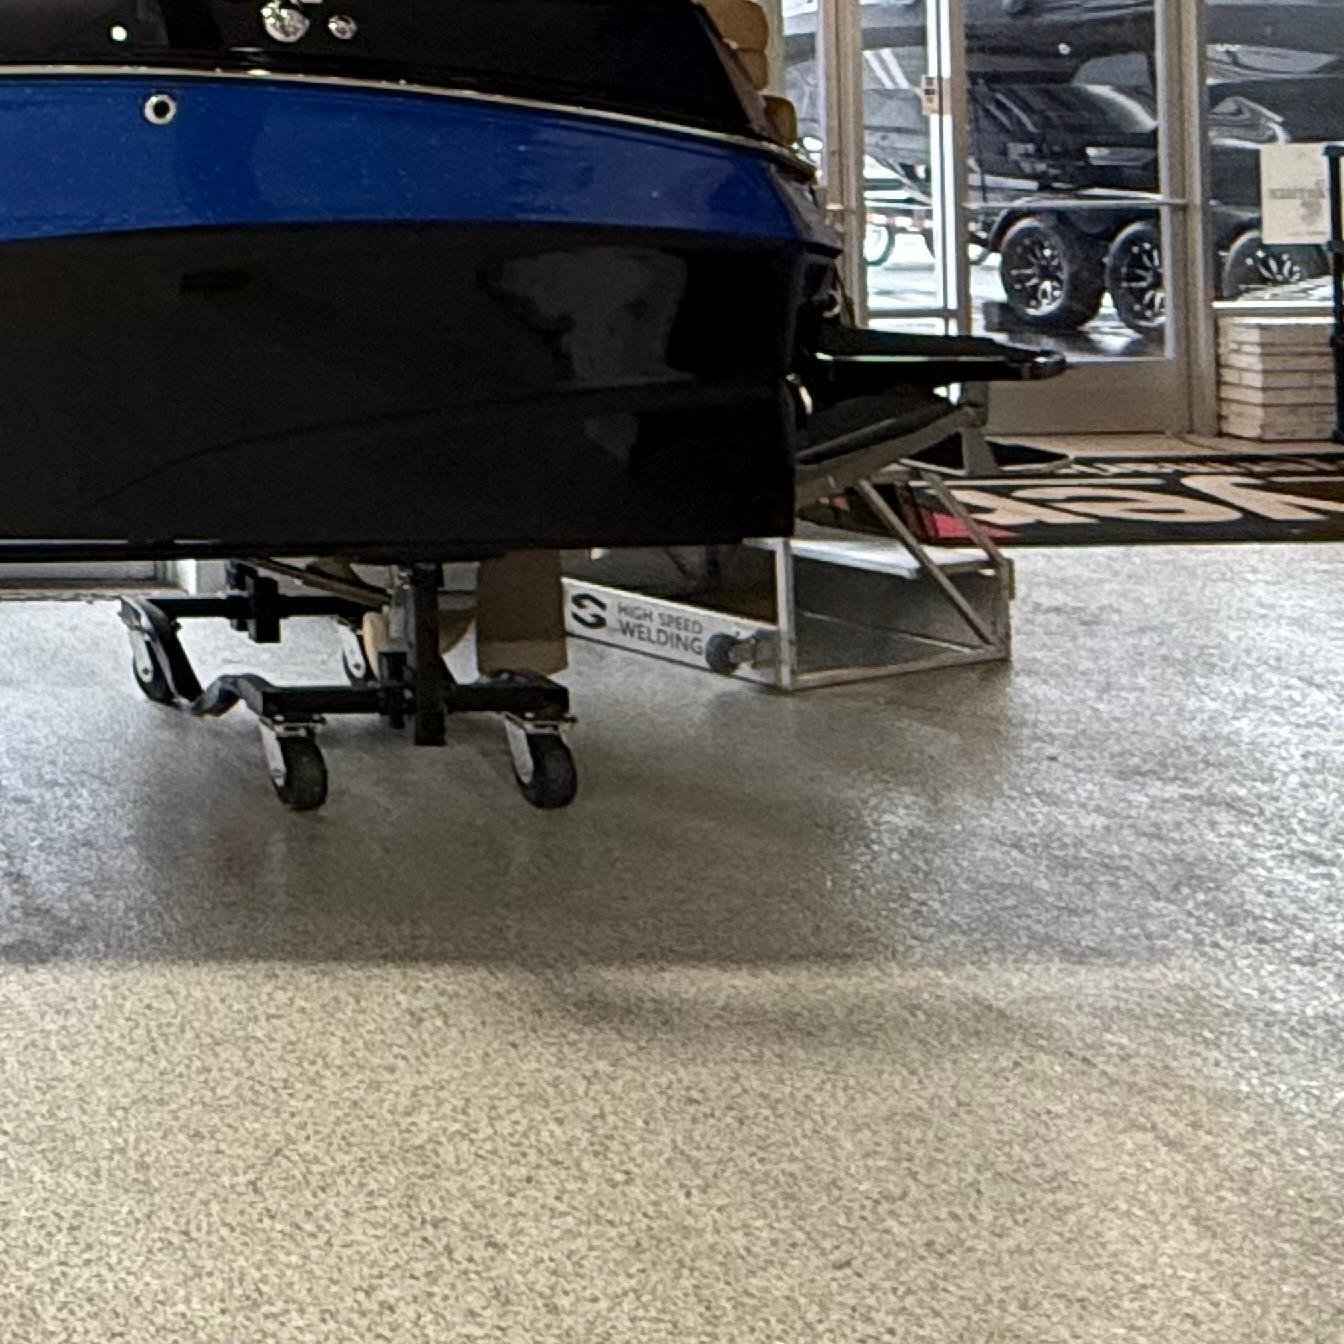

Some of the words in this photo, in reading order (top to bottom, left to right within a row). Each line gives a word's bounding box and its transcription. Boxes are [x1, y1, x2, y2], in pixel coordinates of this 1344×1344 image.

[617, 602, 654, 623] HIGH
[658, 612, 704, 635] SPEED
[618, 619, 703, 656] WELDING
